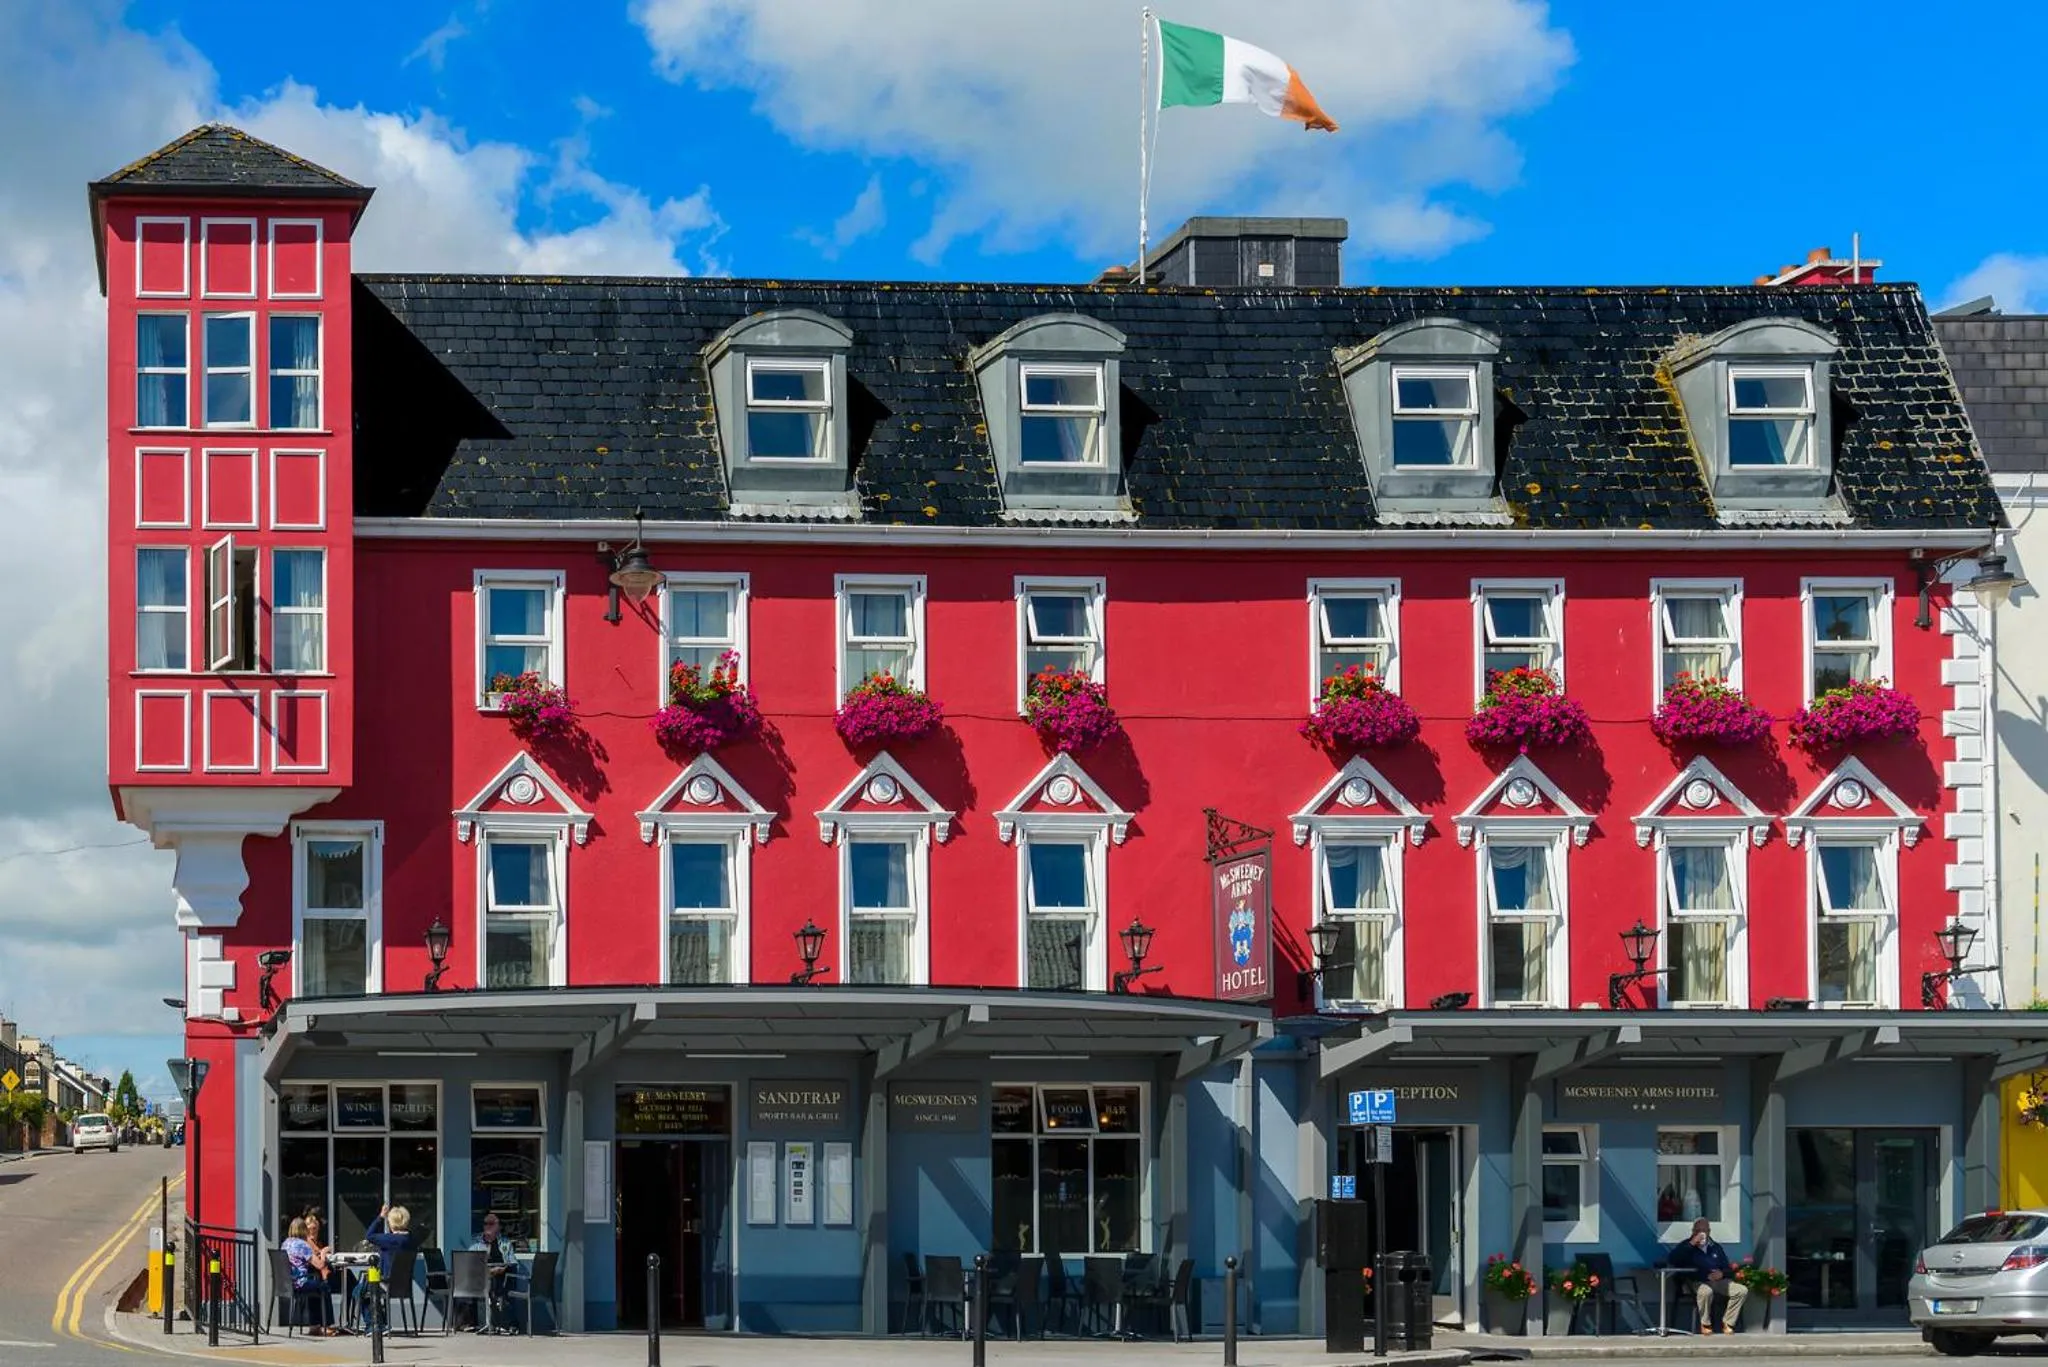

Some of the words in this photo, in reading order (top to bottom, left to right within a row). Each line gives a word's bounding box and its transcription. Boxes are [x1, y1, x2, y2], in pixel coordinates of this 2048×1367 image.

[1231, 879, 1253, 899] ARMS
[1222, 966, 1266, 993] HOTEL
[758, 1091, 841, 1105] SANDTRAP
[1564, 1087, 1639, 1098] MCSWEENEY
[1641, 1087, 1674, 1098] ARMS
[1676, 1087, 1719, 1098] HOTEL
[895, 1094, 977, 1105] MCSWEENEY'S
[1374, 1093, 1388, 1109] P
[289, 1103, 321, 1113] BEER
[344, 1103, 377, 1113] WINE
[392, 1103, 435, 1113] SPIRITS
[1050, 1103, 1083, 1114] FOOD
[1105, 1103, 1128, 1114] BAR
[914, 1113, 940, 1121] SINCE
